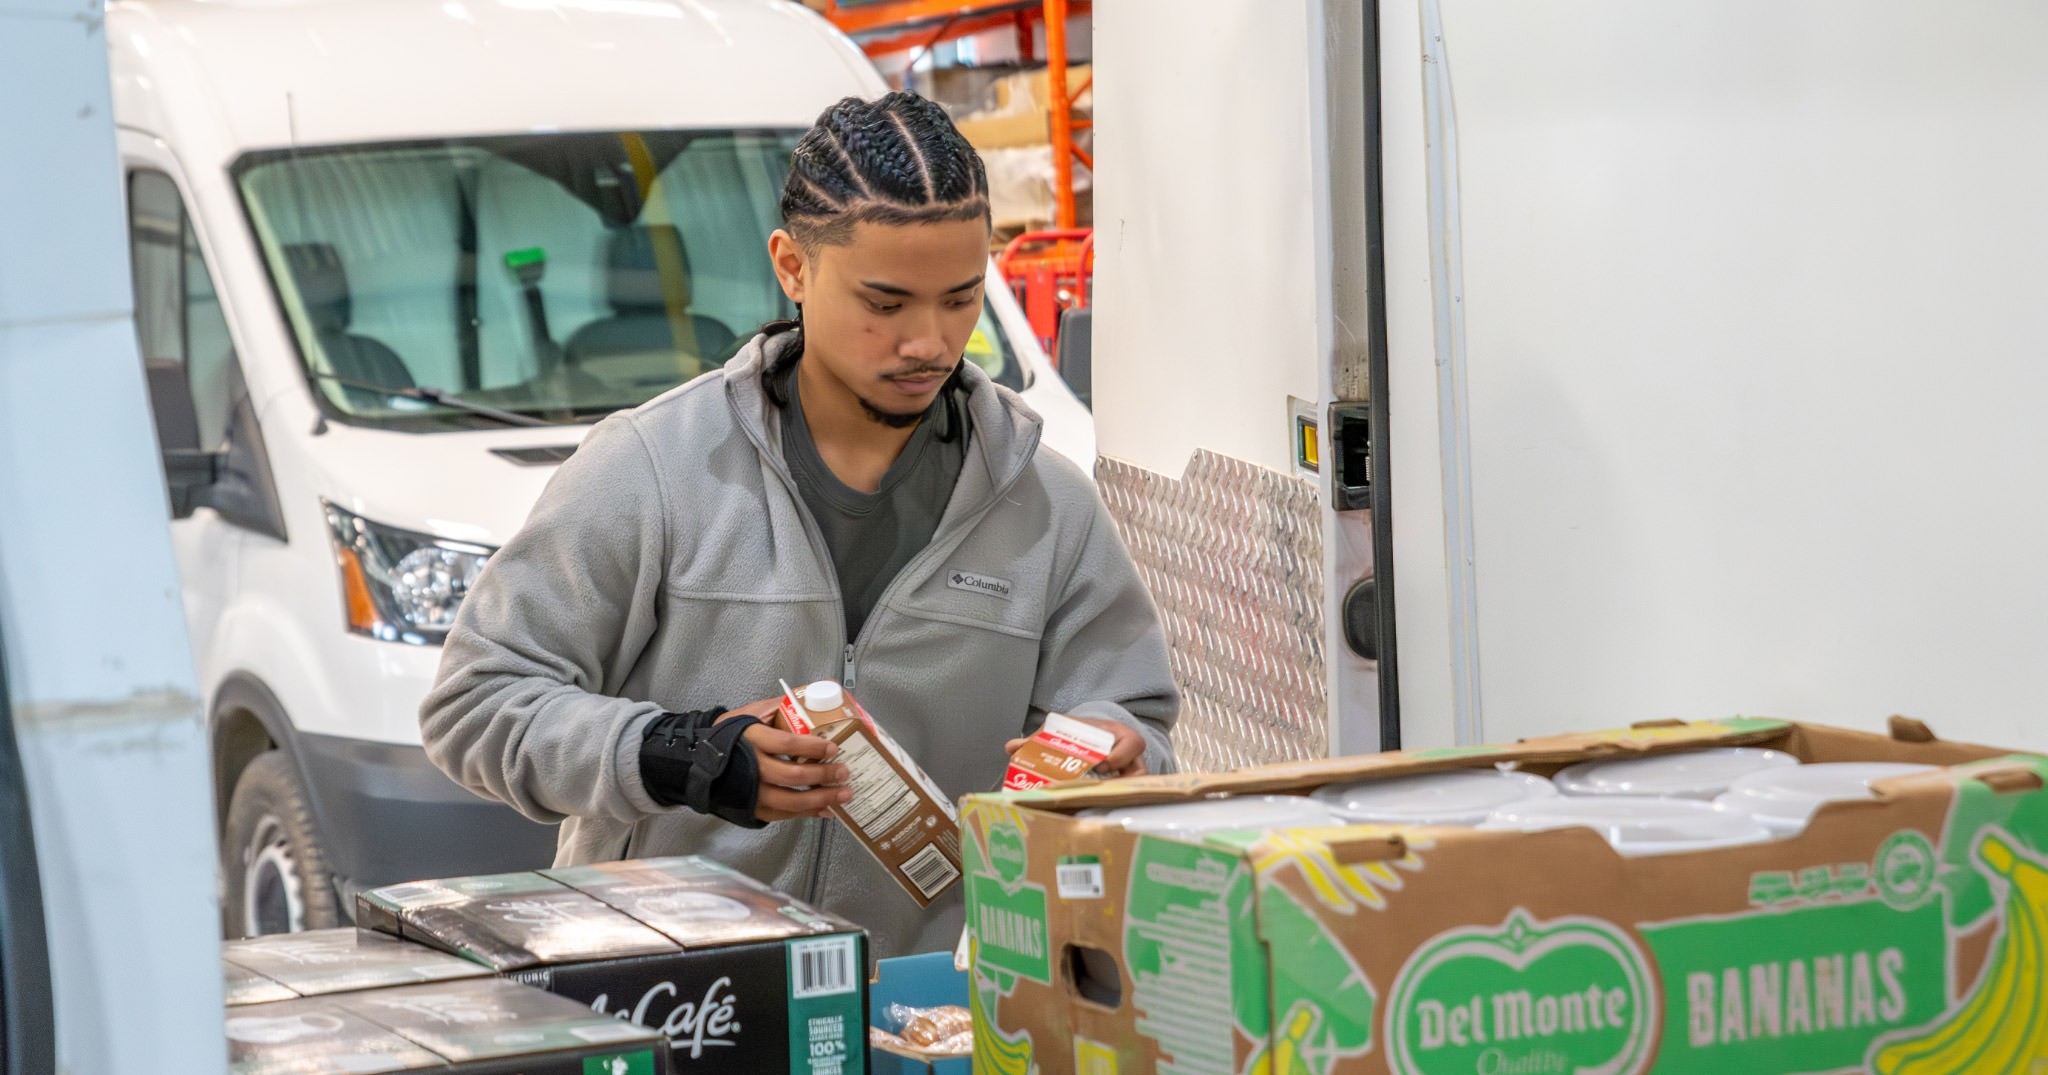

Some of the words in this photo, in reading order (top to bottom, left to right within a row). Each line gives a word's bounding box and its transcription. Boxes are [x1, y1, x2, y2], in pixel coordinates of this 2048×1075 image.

[963, 575, 1009, 595] Columbia
[979, 902, 1042, 960] BANANAS
[1416, 994, 1487, 1050] Del
[1492, 982, 1627, 1042] Monte
[1687, 946, 1908, 1048] BANANAS
[810, 1040, 847, 1057] 100%
